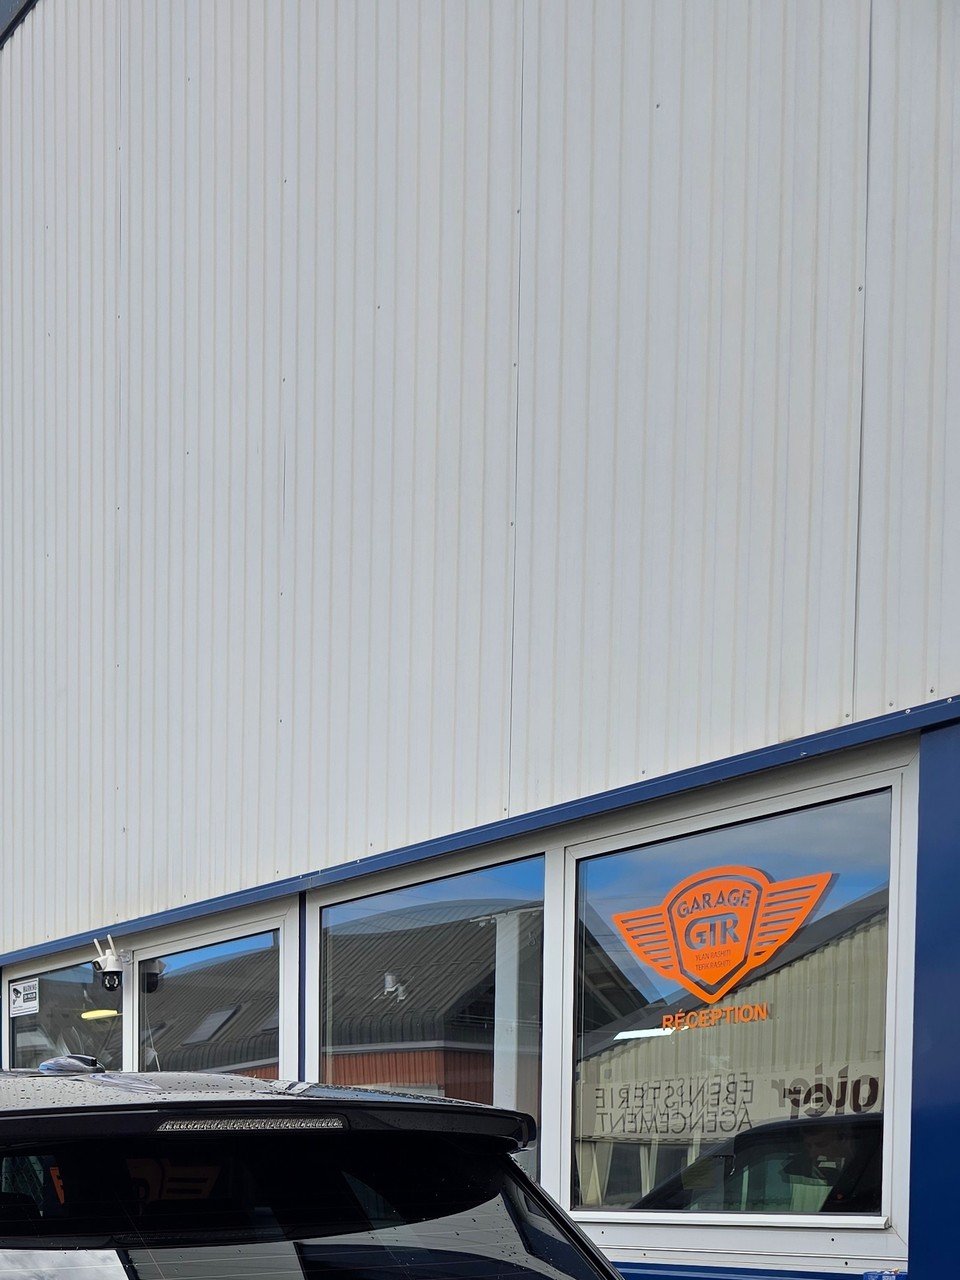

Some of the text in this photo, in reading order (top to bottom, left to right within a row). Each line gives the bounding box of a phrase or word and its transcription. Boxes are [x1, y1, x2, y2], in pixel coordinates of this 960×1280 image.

[677, 888, 752, 918] GARAGE
[684, 912, 740, 950] GTR
[661, 1002, 768, 1031] RÉCEPTION
